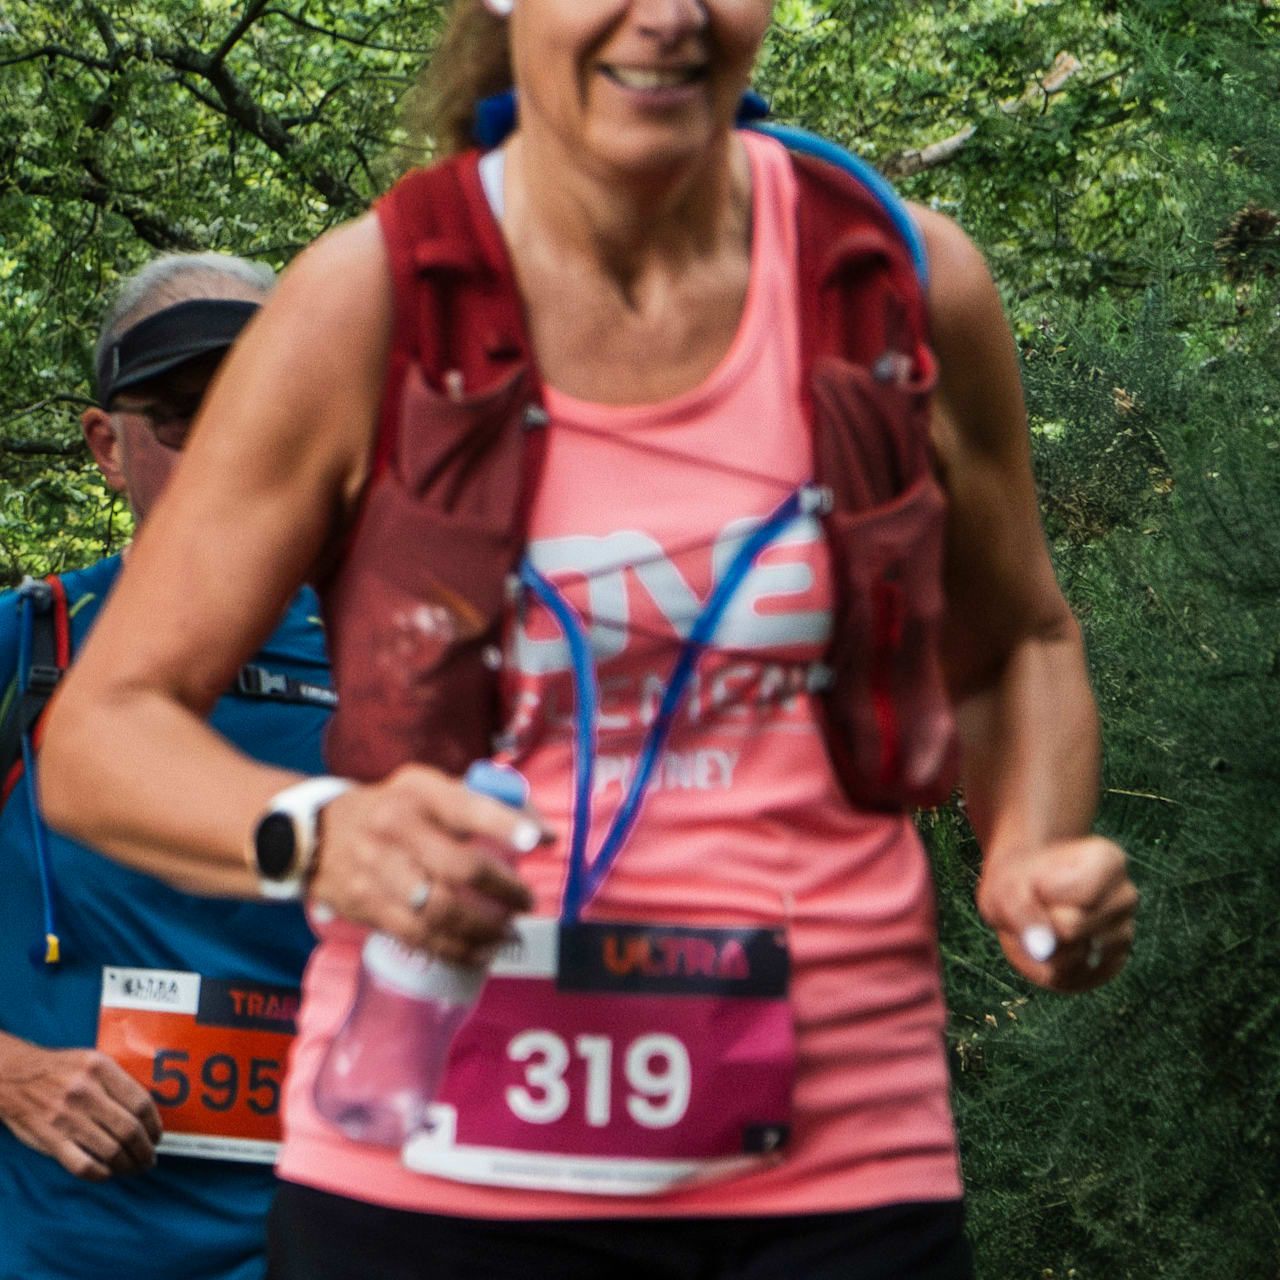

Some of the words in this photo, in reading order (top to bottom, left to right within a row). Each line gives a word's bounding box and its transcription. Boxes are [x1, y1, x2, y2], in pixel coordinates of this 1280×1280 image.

[602, 936, 749, 978] ULTRA
[150, 1050, 281, 1116] 595
[506, 1029, 692, 1129] 319
